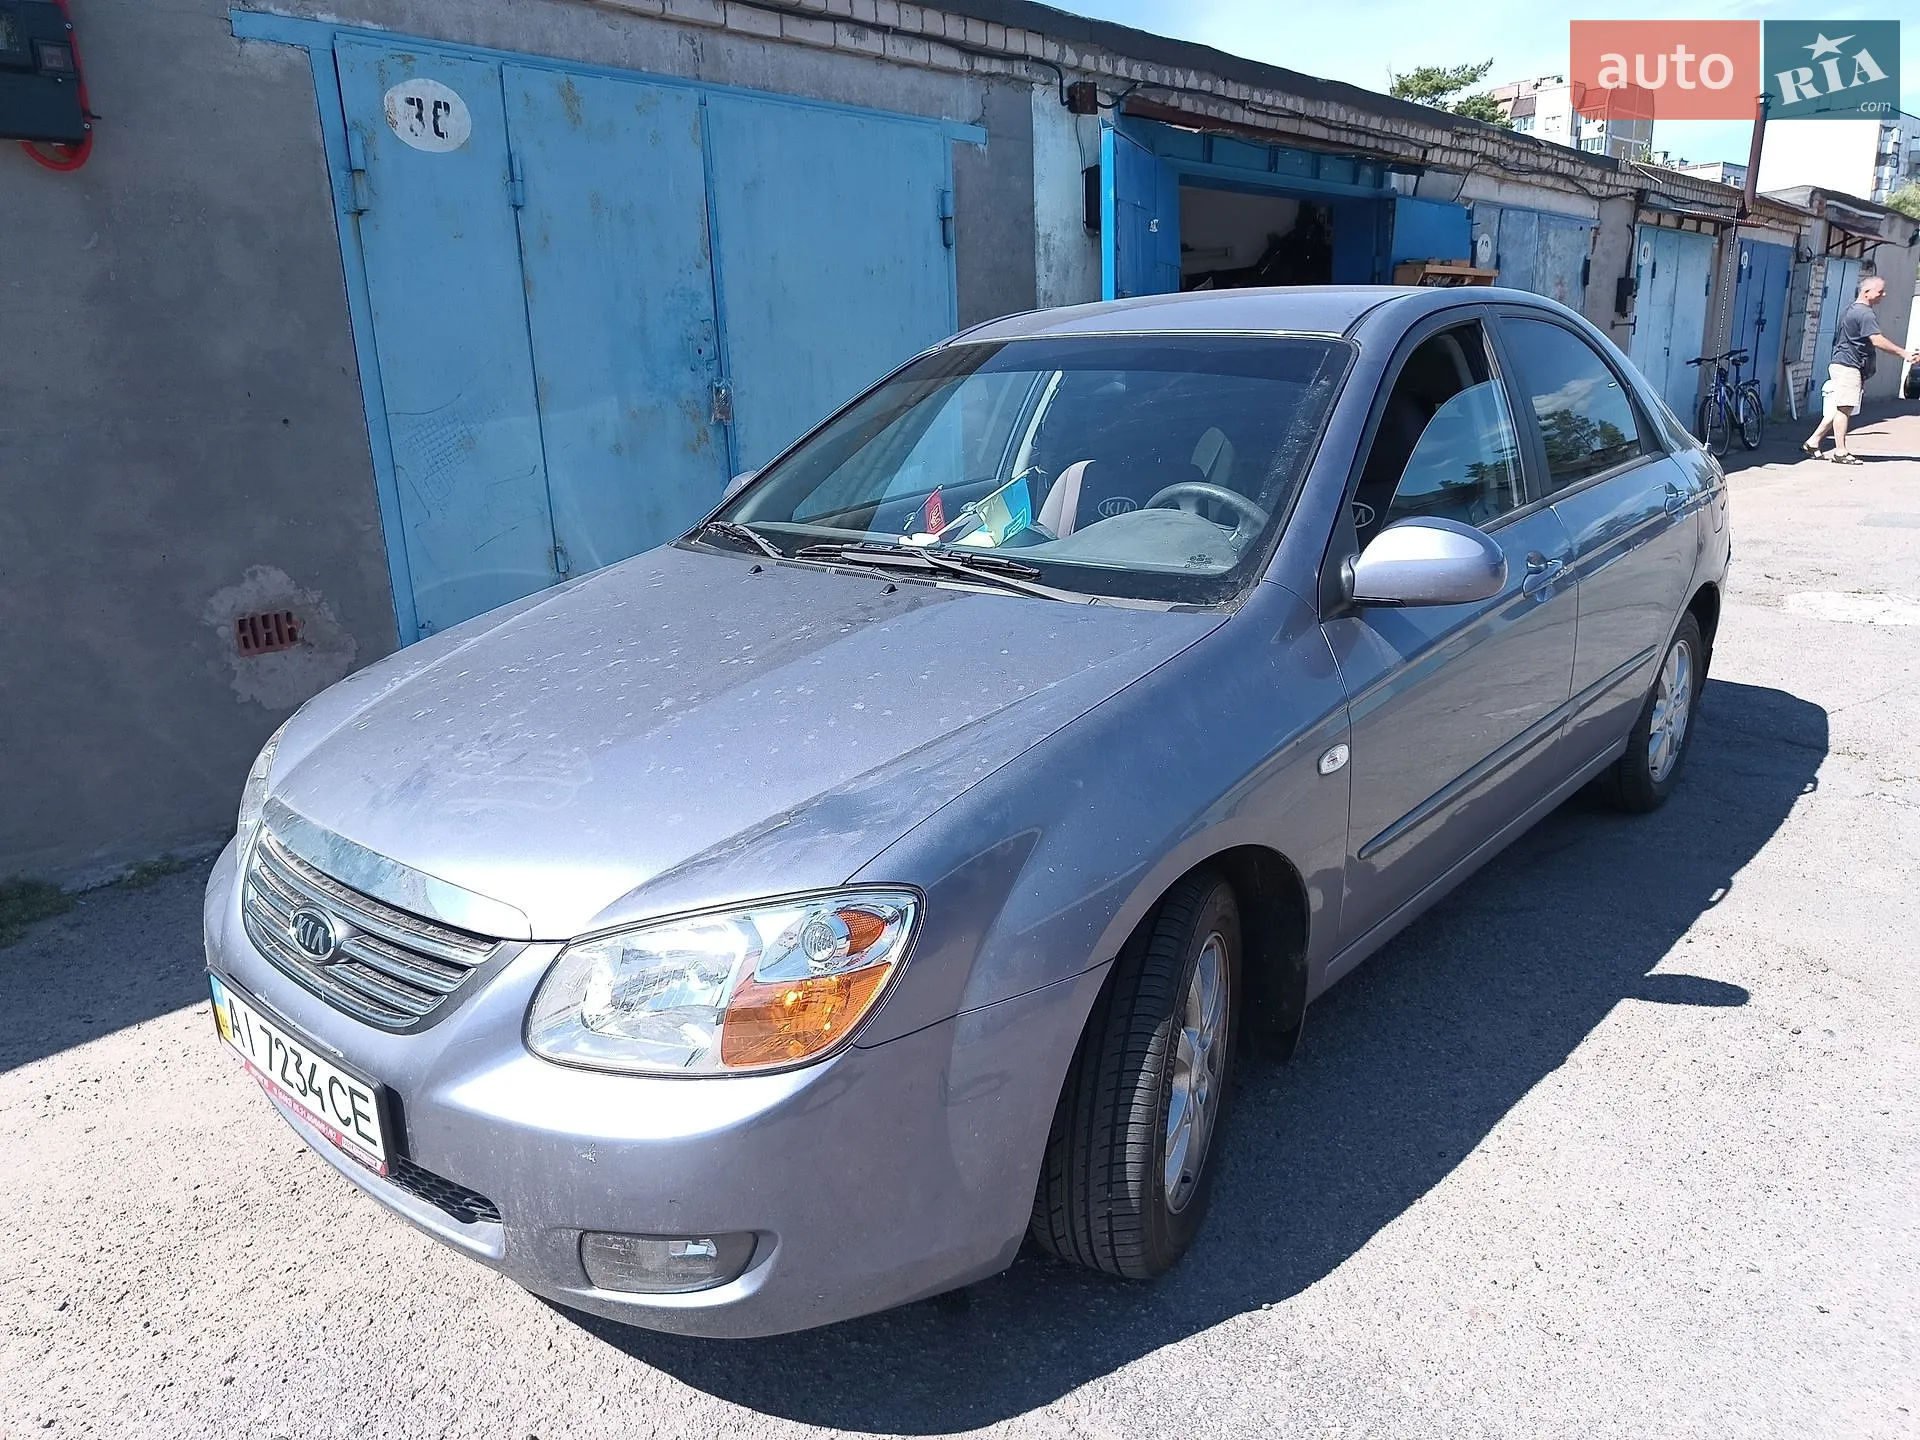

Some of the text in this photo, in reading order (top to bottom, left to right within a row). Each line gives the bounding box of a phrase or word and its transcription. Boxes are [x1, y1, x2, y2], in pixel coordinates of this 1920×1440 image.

[1105, 501, 1131, 515] KIA
[295, 914, 325, 954] KIA
[259, 1023, 327, 1113] 7234
[328, 1075, 378, 1147] CE
